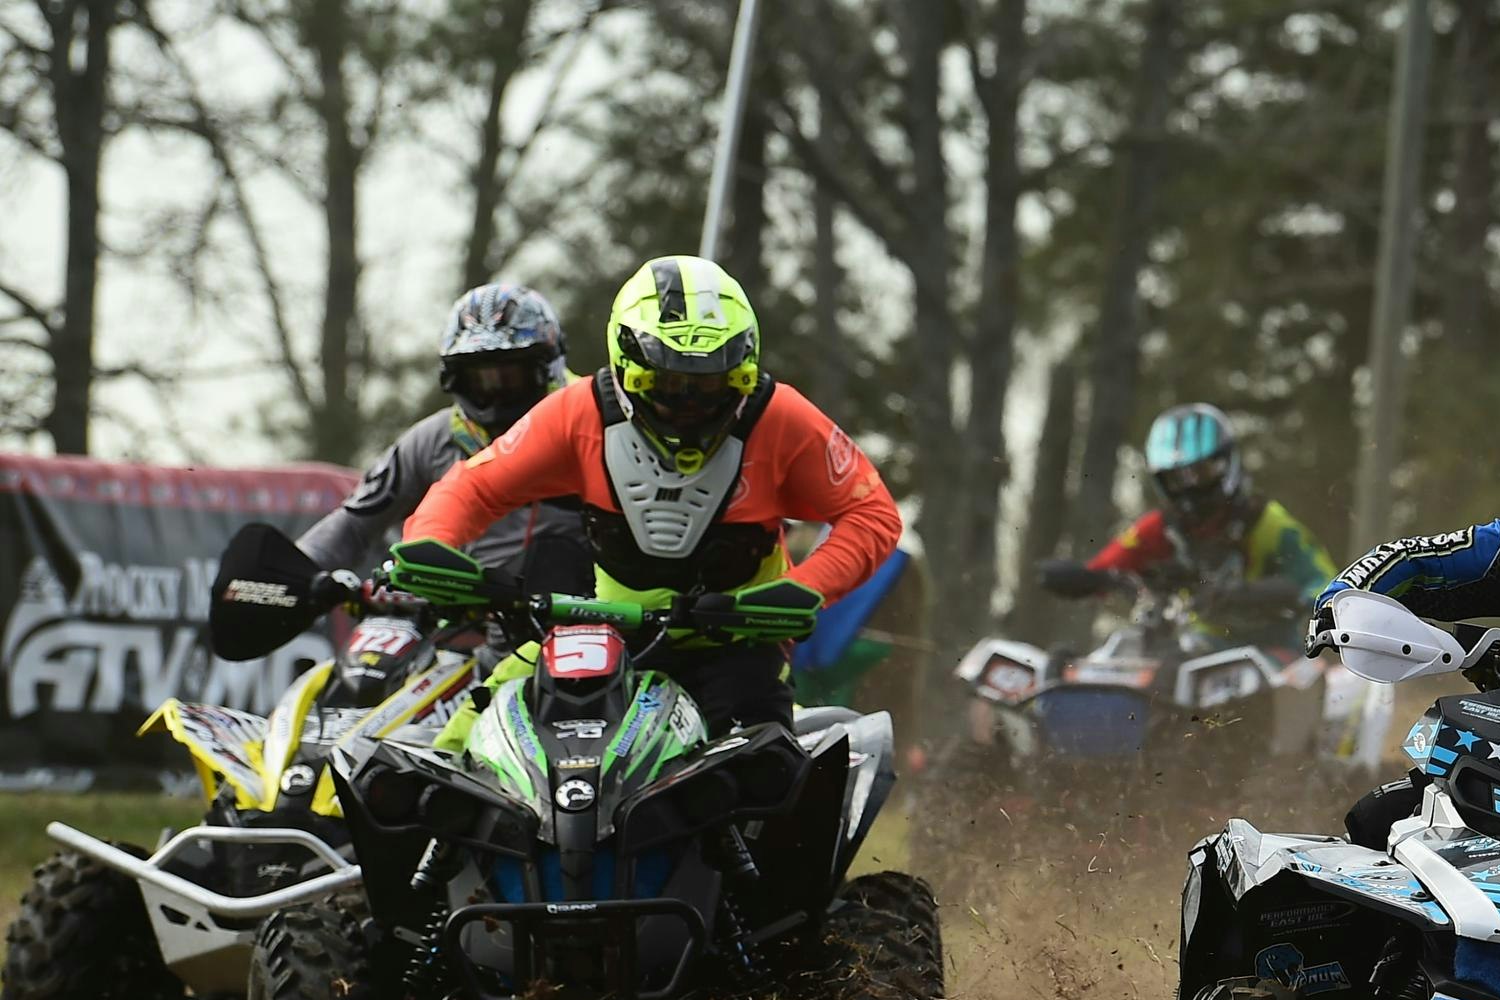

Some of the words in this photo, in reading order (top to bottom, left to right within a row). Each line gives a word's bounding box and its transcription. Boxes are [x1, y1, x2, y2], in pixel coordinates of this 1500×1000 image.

[228, 579, 288, 596] MOOSE
[9, 621, 198, 719] ATV
[553, 634, 609, 673] 5
